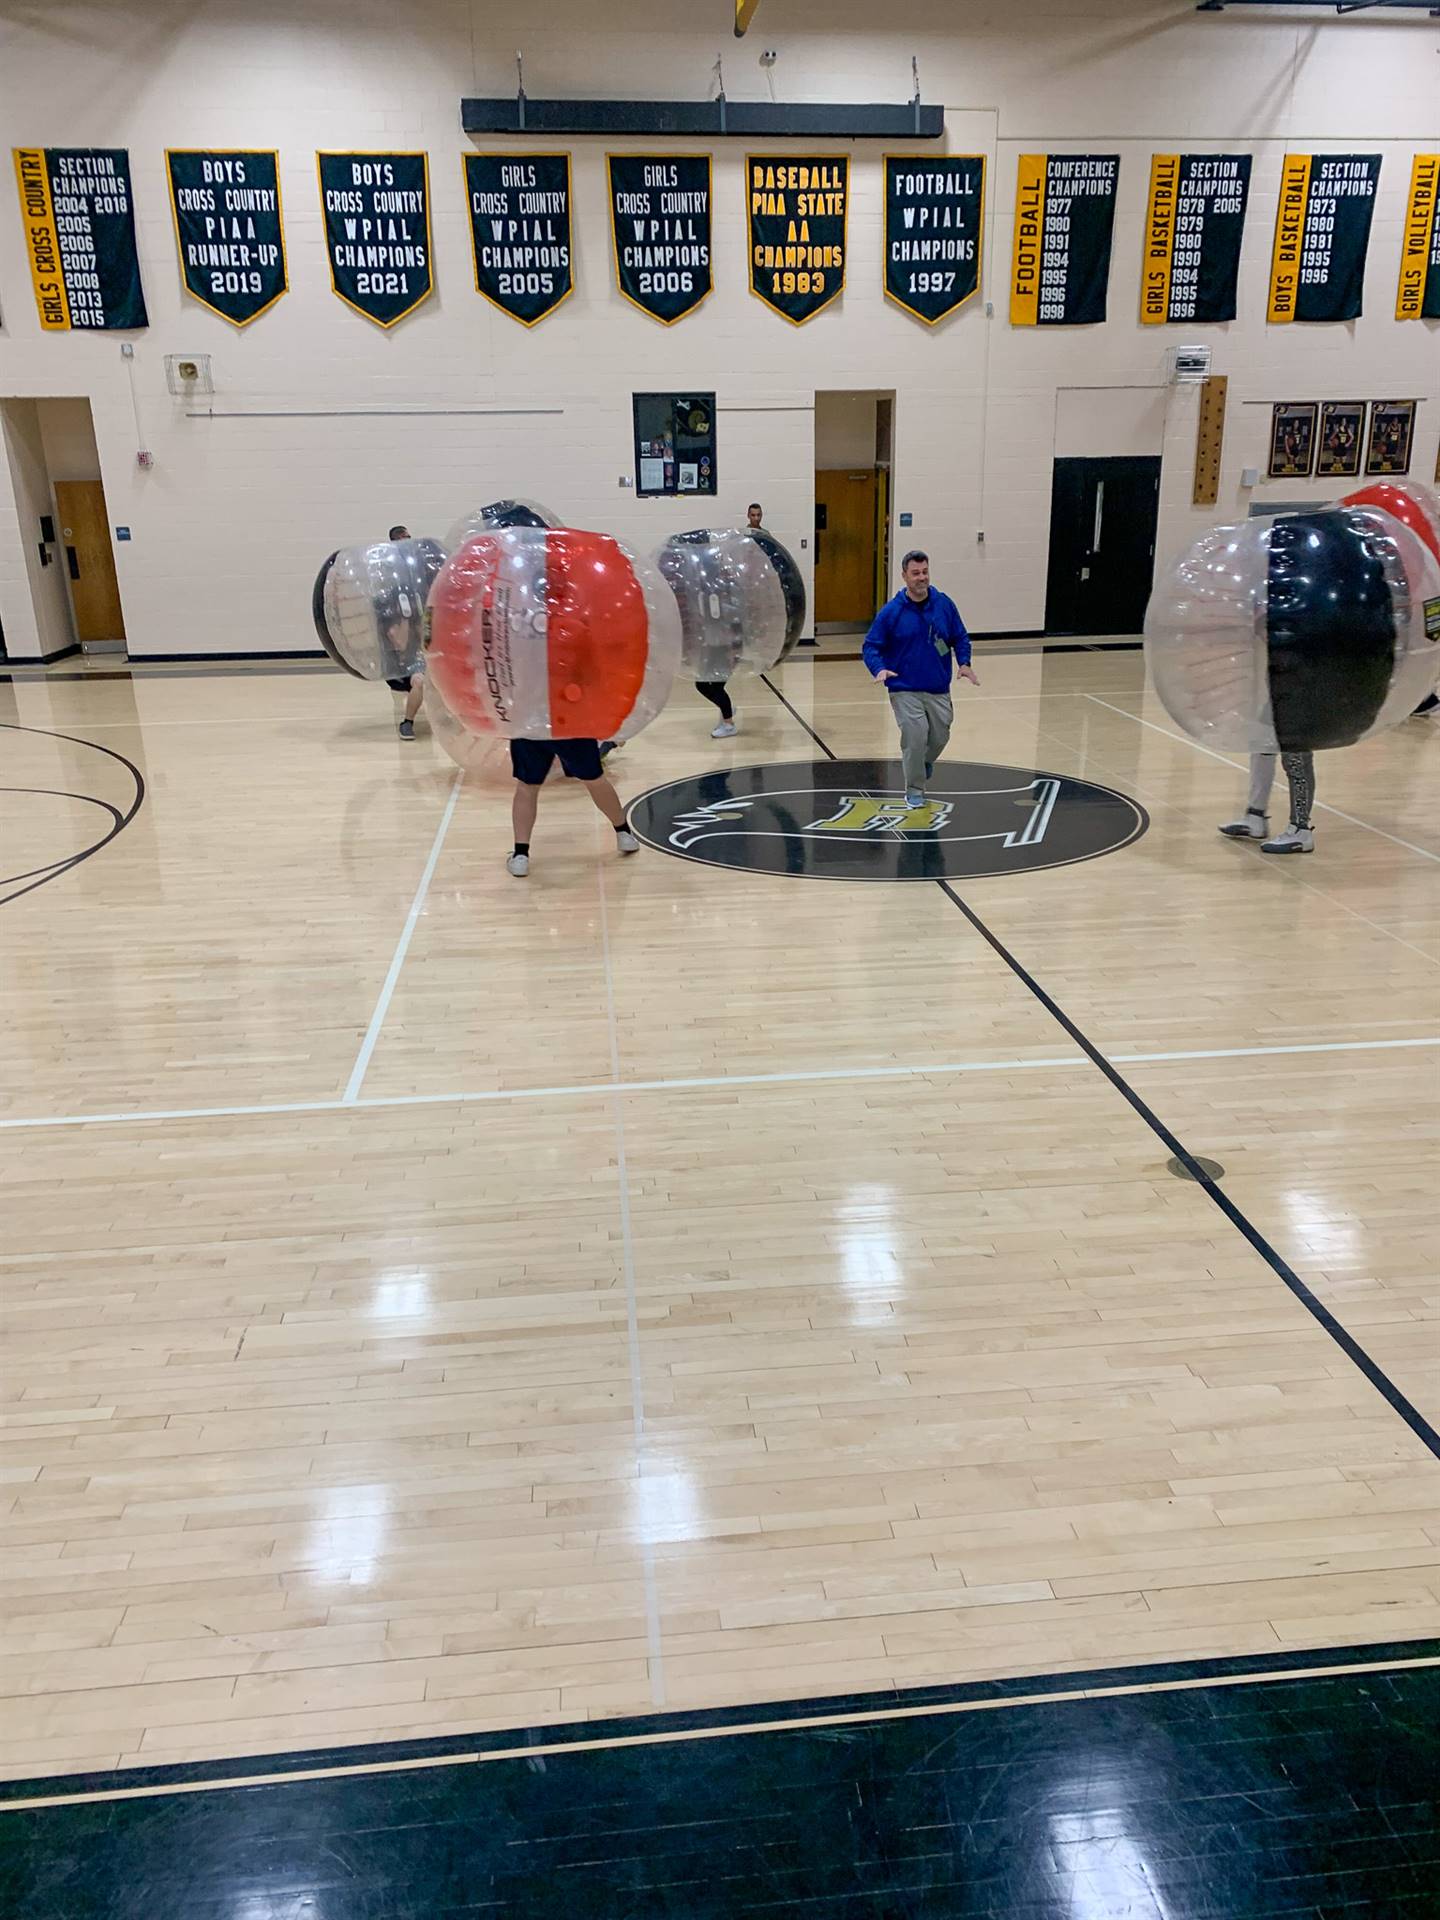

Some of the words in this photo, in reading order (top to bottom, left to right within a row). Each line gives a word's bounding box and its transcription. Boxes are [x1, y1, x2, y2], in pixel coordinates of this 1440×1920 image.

[59, 158, 114, 176] SECTION
[203, 161, 245, 183] BOYS
[352, 163, 393, 185] BOYS
[502, 165, 536, 187] GIRLS
[644, 165, 677, 187] GIRLS
[1048, 162, 1115, 177] CONFERENCE
[1190, 162, 1238, 178] SECTION
[1321, 163, 1368, 179] SECTION
[19, 151, 46, 217] COUNTRY
[53, 177, 125, 194] CHAMPIONS
[754, 166, 842, 189] BASEBALL
[896, 174, 973, 195] FOOTBALL
[1049, 180, 1112, 196] CHAMPIONS
[1181, 180, 1242, 195] CHAMPIONS
[1311, 180, 1373, 196] CHAMPIONS
[54, 197, 88, 213] 2004
[178, 189, 215, 211] CROSS
[225, 189, 275, 211] COUNTRY
[327, 191, 363, 212] CROSS
[374, 191, 423, 213] COUNTRY
[473, 192, 508, 214] CROSS
[519, 192, 566, 213] COUNTRY
[617, 193, 650, 214] CROSS
[661, 192, 707, 213] COUNTRY
[753, 194, 786, 215] PIAA
[797, 194, 844, 215] STATE
[1047, 199, 1072, 214] 1977
[1151, 160, 1175, 257] BASKETBALL
[1177, 198, 1204, 213] 1978
[1213, 198, 1241, 213] 2005
[1308, 199, 1336, 214] 1973
[1408, 161, 1435, 256] VOLLEYBALL
[1279, 164, 1305, 261] BASKETBALL
[57, 217, 91, 232] 2005
[1045, 217, 1070, 232] 1980
[1176, 216, 1203, 231] 1979
[1306, 217, 1334, 231] 1980
[60, 236, 94, 251] 2006
[1017, 179, 1040, 294] FOOTBALL
[1044, 235, 1069, 250] 1991
[1175, 234, 1202, 249] 1980
[1304, 234, 1332, 249] 1981
[31, 227, 56, 273] CROSS
[188, 245, 278, 266] RUNNER-UP
[335, 246, 425, 267] CHAMPIONS
[483, 247, 568, 268] CHAMPIONS
[624, 245, 708, 267] CHAMPIONS
[755, 245, 842, 268] CHAMPIONS
[892, 240, 974, 261] CHAMPIONS
[1173, 251, 1201, 266] 1990
[1302, 251, 1330, 266] 1995
[63, 254, 96, 270] 2007
[1043, 253, 1068, 267] 1994
[66, 273, 98, 289] 2008
[211, 272, 262, 293] 2019
[357, 274, 409, 294] 2021
[499, 274, 553, 294] 2005
[639, 272, 693, 293] 2006
[773, 272, 825, 293] 1983
[909, 272, 956, 293] 1997
[1042, 270, 1067, 285] 1995
[1172, 269, 1198, 283] 1994
[1301, 269, 1328, 284] 1996
[69, 291, 102, 307] 2013
[1041, 288, 1066, 302] 1996
[1147, 272, 1165, 314] GIRLS
[1171, 286, 1197, 301] 1995
[1274, 276, 1293, 312] BOYS
[1402, 271, 1421, 313] GIRLS
[45, 283, 64, 324] GIRLS
[1039, 305, 1064, 319] 1998
[1169, 303, 1195, 318] 1996
[72, 310, 104, 325] 2015
[481, 548, 511, 723] KNOCKER
